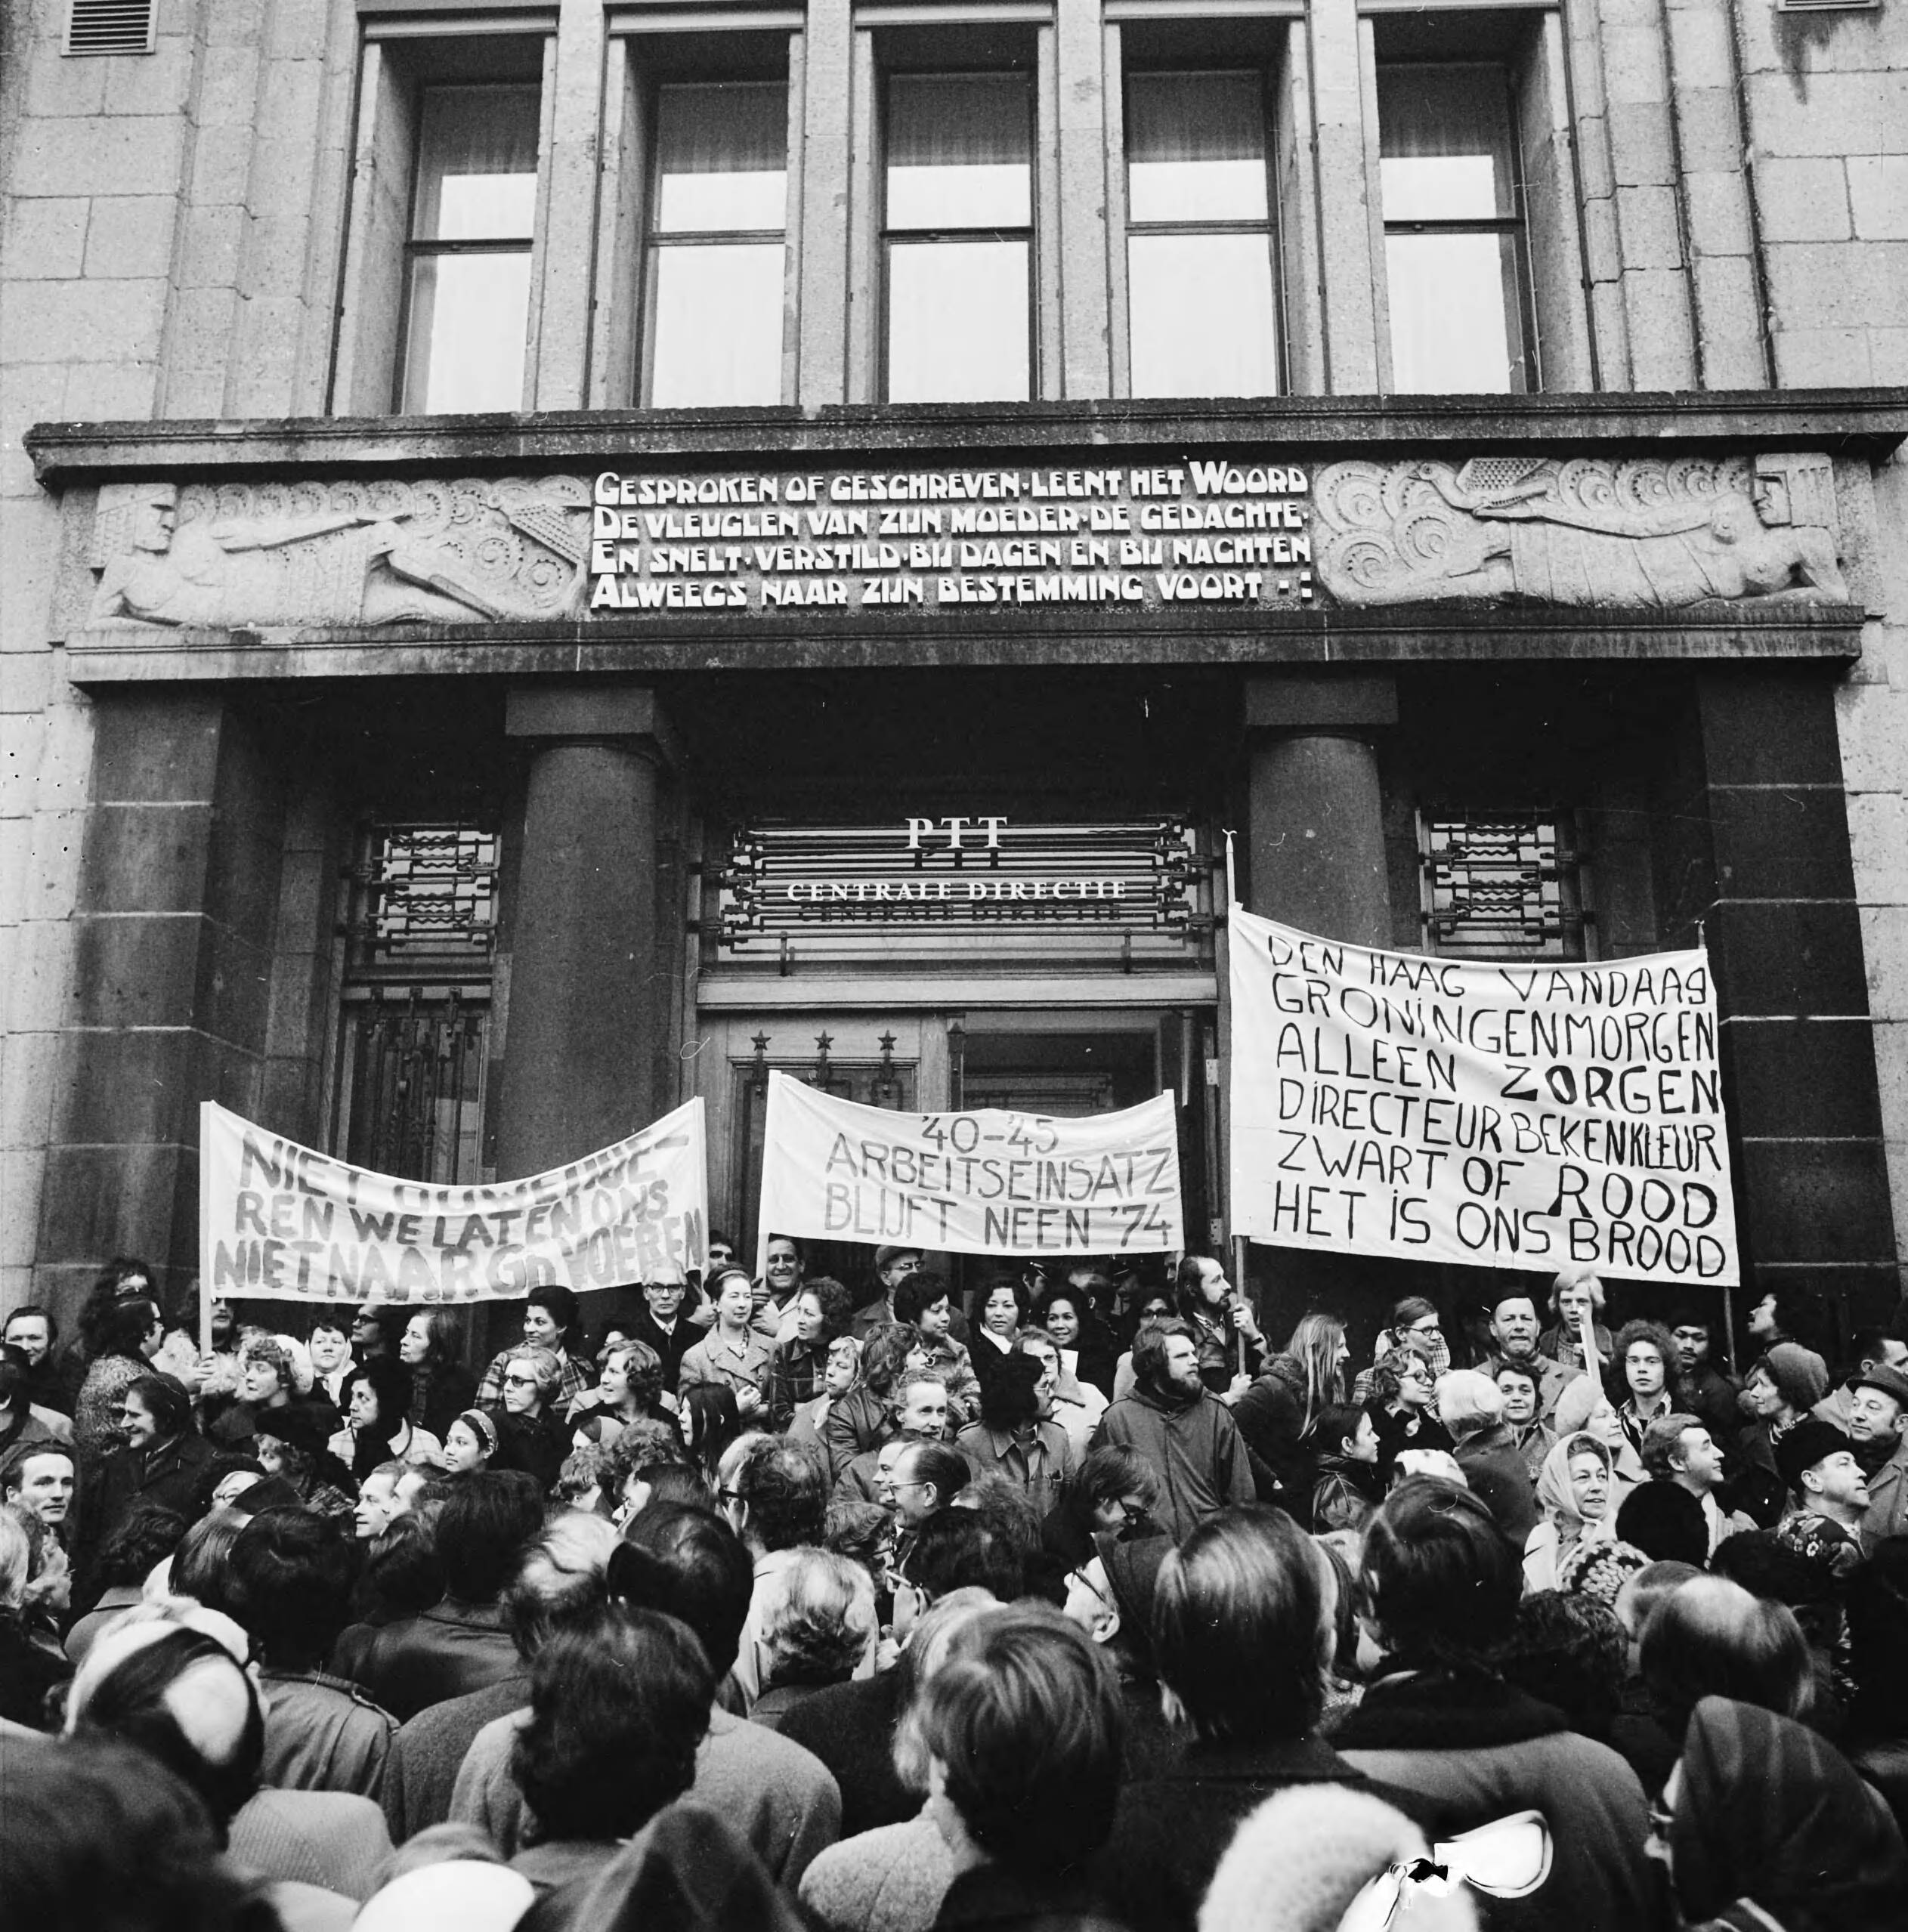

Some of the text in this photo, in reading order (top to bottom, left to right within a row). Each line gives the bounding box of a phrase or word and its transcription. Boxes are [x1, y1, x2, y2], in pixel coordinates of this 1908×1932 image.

[595, 472, 778, 505] GESPROKEN
[785, 476, 824, 502] OF
[1131, 469, 1184, 496] HET
[1189, 460, 1308, 495] WOORD
[593, 505, 638, 539] DE
[645, 512, 798, 539] VLEUGLEN
[807, 509, 868, 536] VAN
[878, 509, 942, 535] ZIJN
[592, 540, 639, 573] EN
[960, 539, 1060, 567] DAGEN
[1071, 539, 1109, 566] EN
[1120, 539, 1163, 565] BIJ
[1173, 537, 1311, 564] NACHTEN
[590, 572, 1262, 608] ALWEEGS NAAR ZIJN BESTEMMING VOORT
[905, 816, 1008, 849] PTT
[787, 879, 1127, 904] CENTRALE DIRECTIE
[1269, 935, 1344, 977] DEN
[1370, 953, 1465, 997] HAAG
[1276, 1022, 1720, 1115] ALLEEN ZORGEN
[825, 1133, 1174, 1201] ARBEITSEINSATZ
[1277, 1130, 1719, 1229] ZWART OF ROOD
[235, 1179, 668, 1248] REN WE LATEN ONS
[824, 1182, 957, 1243] BLIJFT
[985, 1207, 1090, 1249] NEEN
[1273, 1180, 1366, 1240] HET
[1456, 1202, 1550, 1254] ONS
[1569, 1216, 1726, 1278] BROOD
